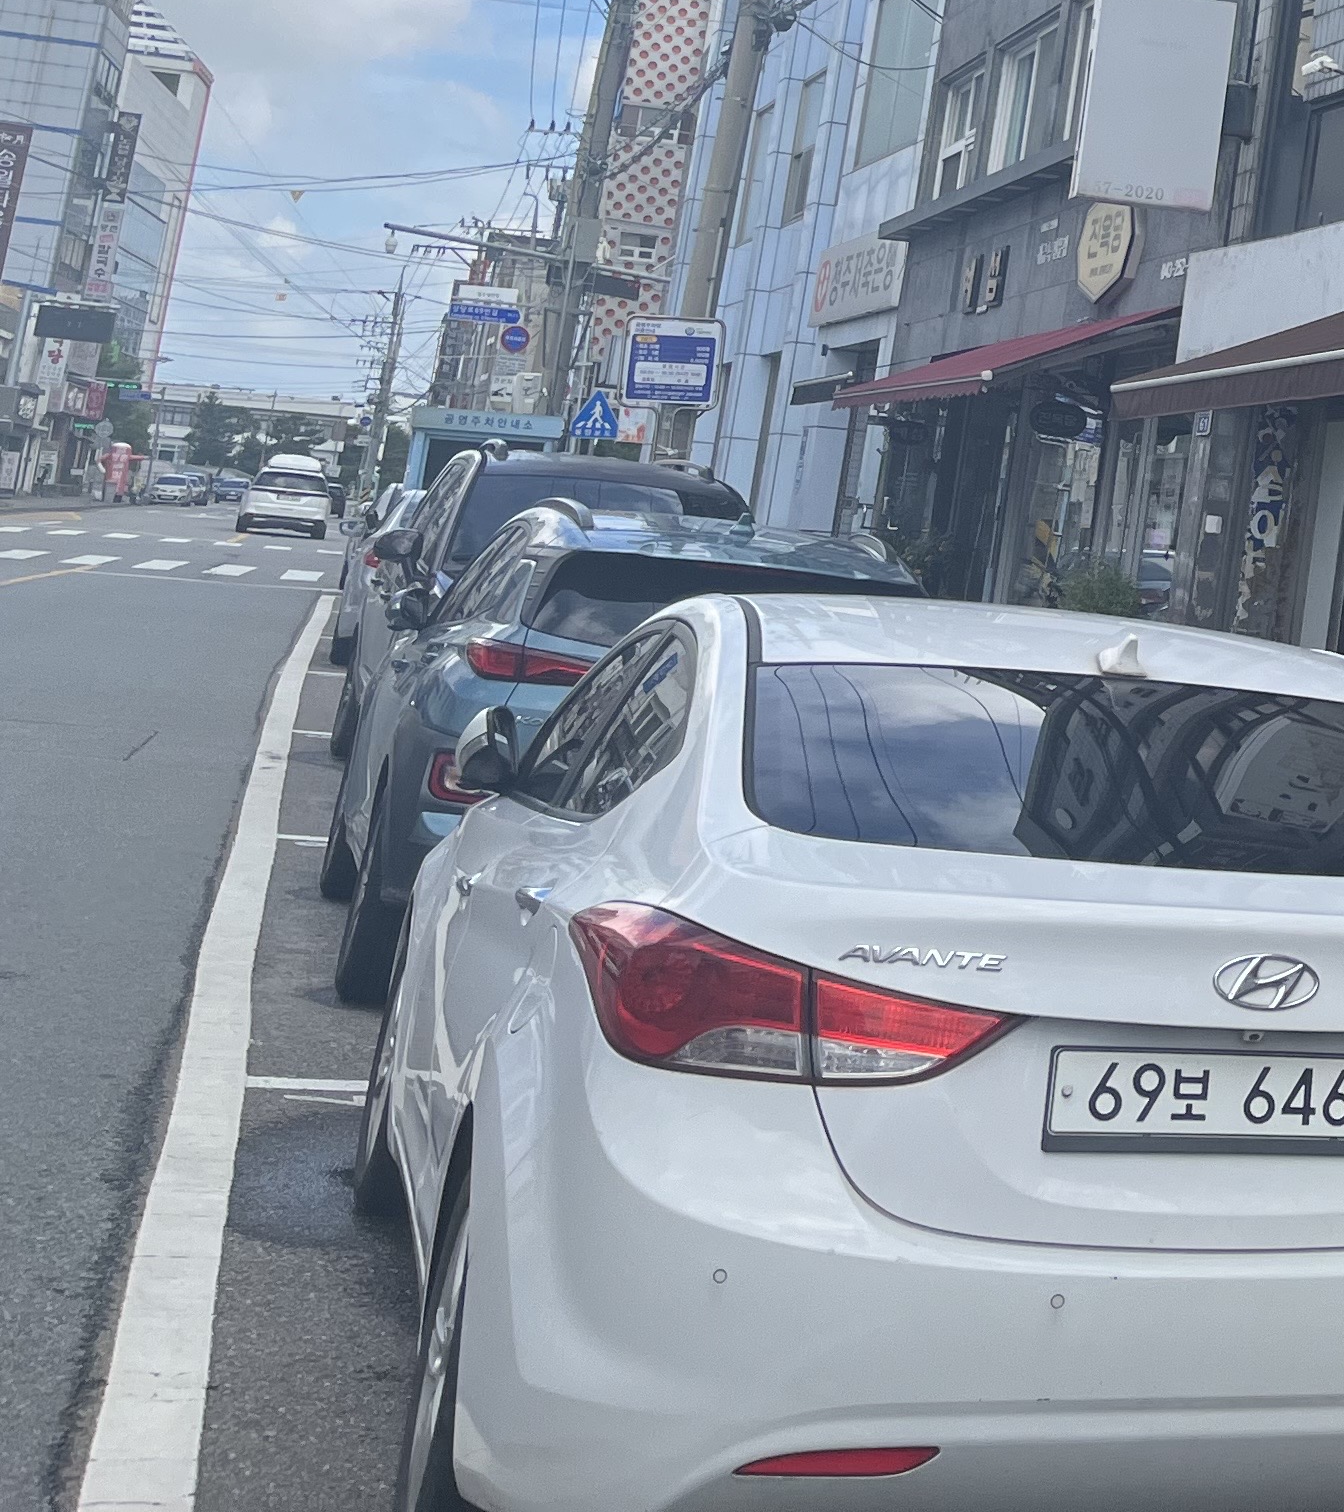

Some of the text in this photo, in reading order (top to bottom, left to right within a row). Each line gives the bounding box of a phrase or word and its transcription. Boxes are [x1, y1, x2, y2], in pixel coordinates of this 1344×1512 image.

[443, 413, 534, 430] 공영주차안내소
[837, 943, 1008, 973] AVANTE
[1086, 1062, 1208, 1124] 69보
